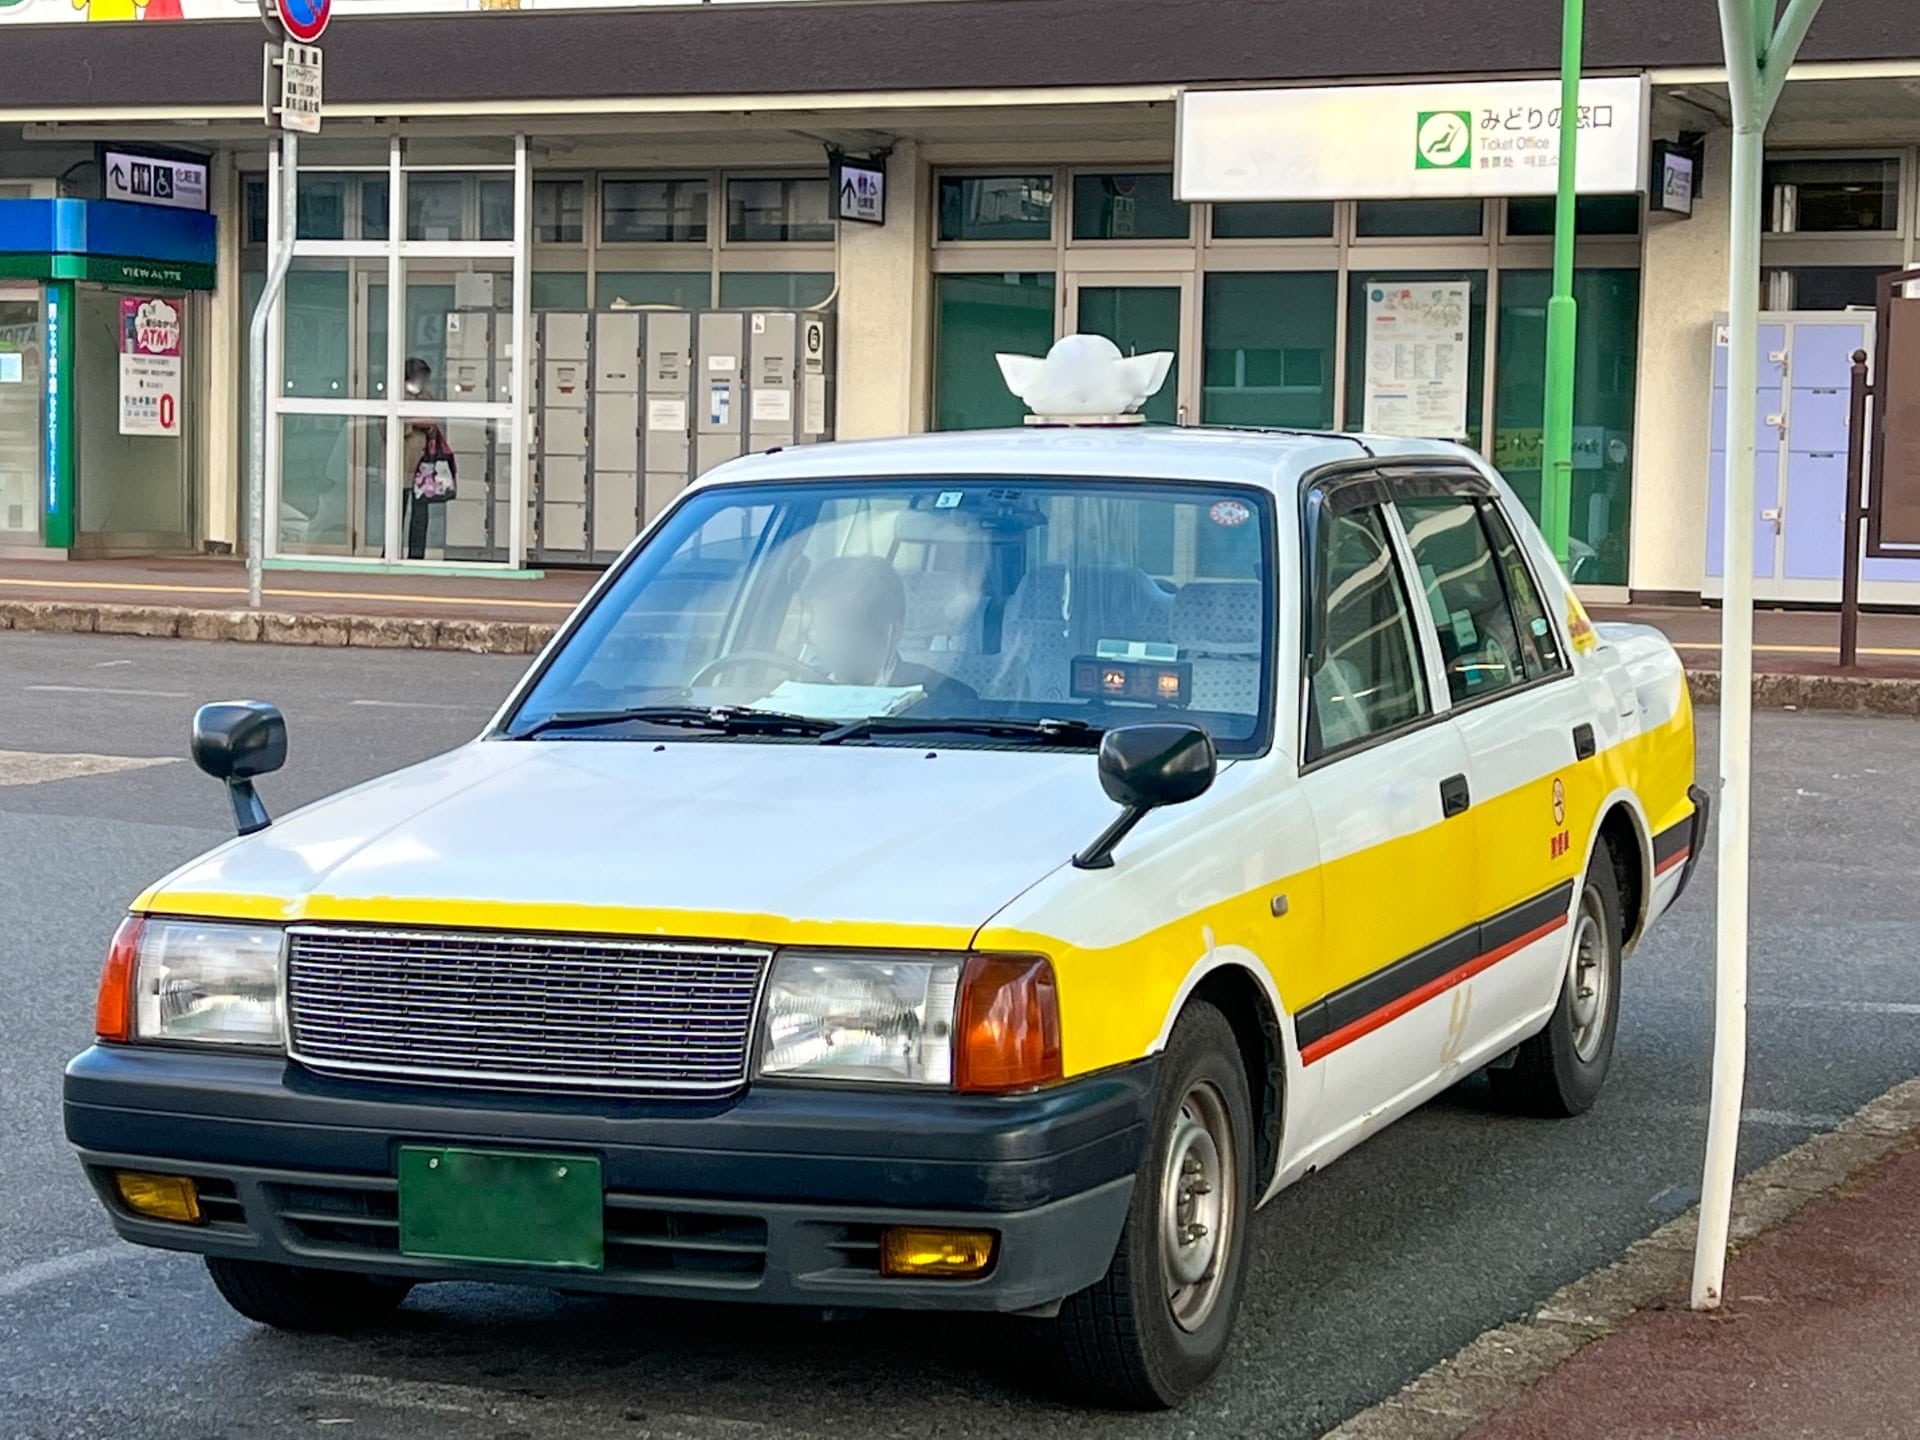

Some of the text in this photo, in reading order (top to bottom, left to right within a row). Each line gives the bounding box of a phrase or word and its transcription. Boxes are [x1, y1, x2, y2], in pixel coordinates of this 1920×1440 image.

[1480, 105, 1612, 130] みどりの窓口
[1480, 137, 1549, 150] Ticket Office
[141, 329, 168, 346] ATM
[160, 394, 175, 429] 0
